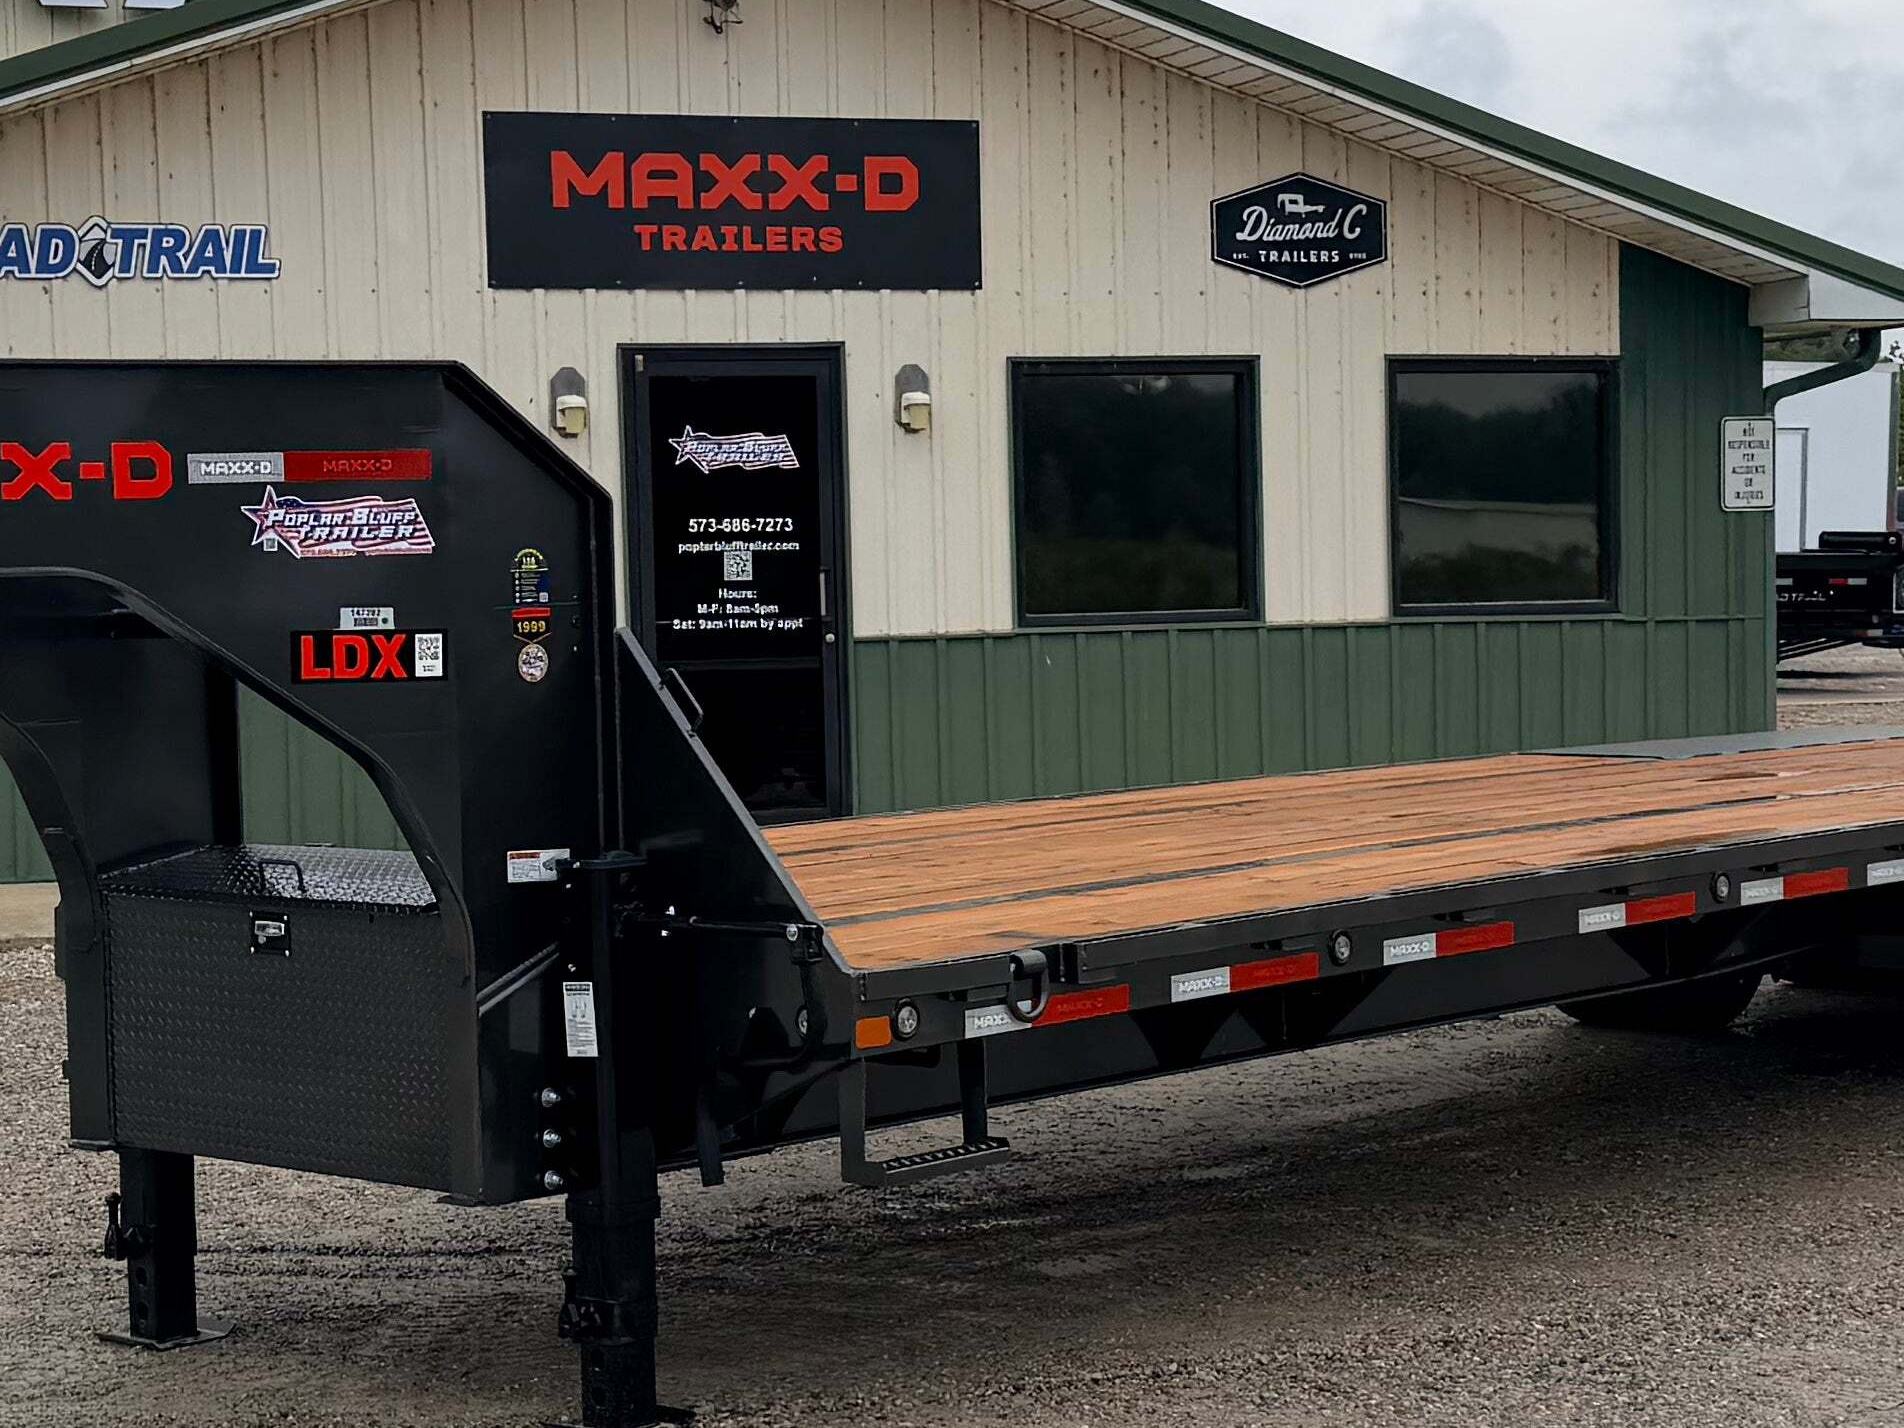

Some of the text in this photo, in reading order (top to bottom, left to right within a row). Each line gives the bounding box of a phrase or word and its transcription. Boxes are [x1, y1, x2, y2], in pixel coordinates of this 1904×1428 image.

[550, 150, 919, 211] MAXX-D
[1235, 203, 1368, 242] Diamond C
[633, 224, 844, 253] TRAILERS
[108, 224, 280, 278] TRAIL
[1258, 250, 1340, 262] TRAILERS
[200, 460, 272, 476] MAXX-D
[322, 458, 393, 472] MAXX-D
[298, 524, 414, 540] TRAILER
[688, 518, 794, 532] 573-686-7273
[516, 620, 546, 633] 1999
[300, 634, 407, 680] LDX
